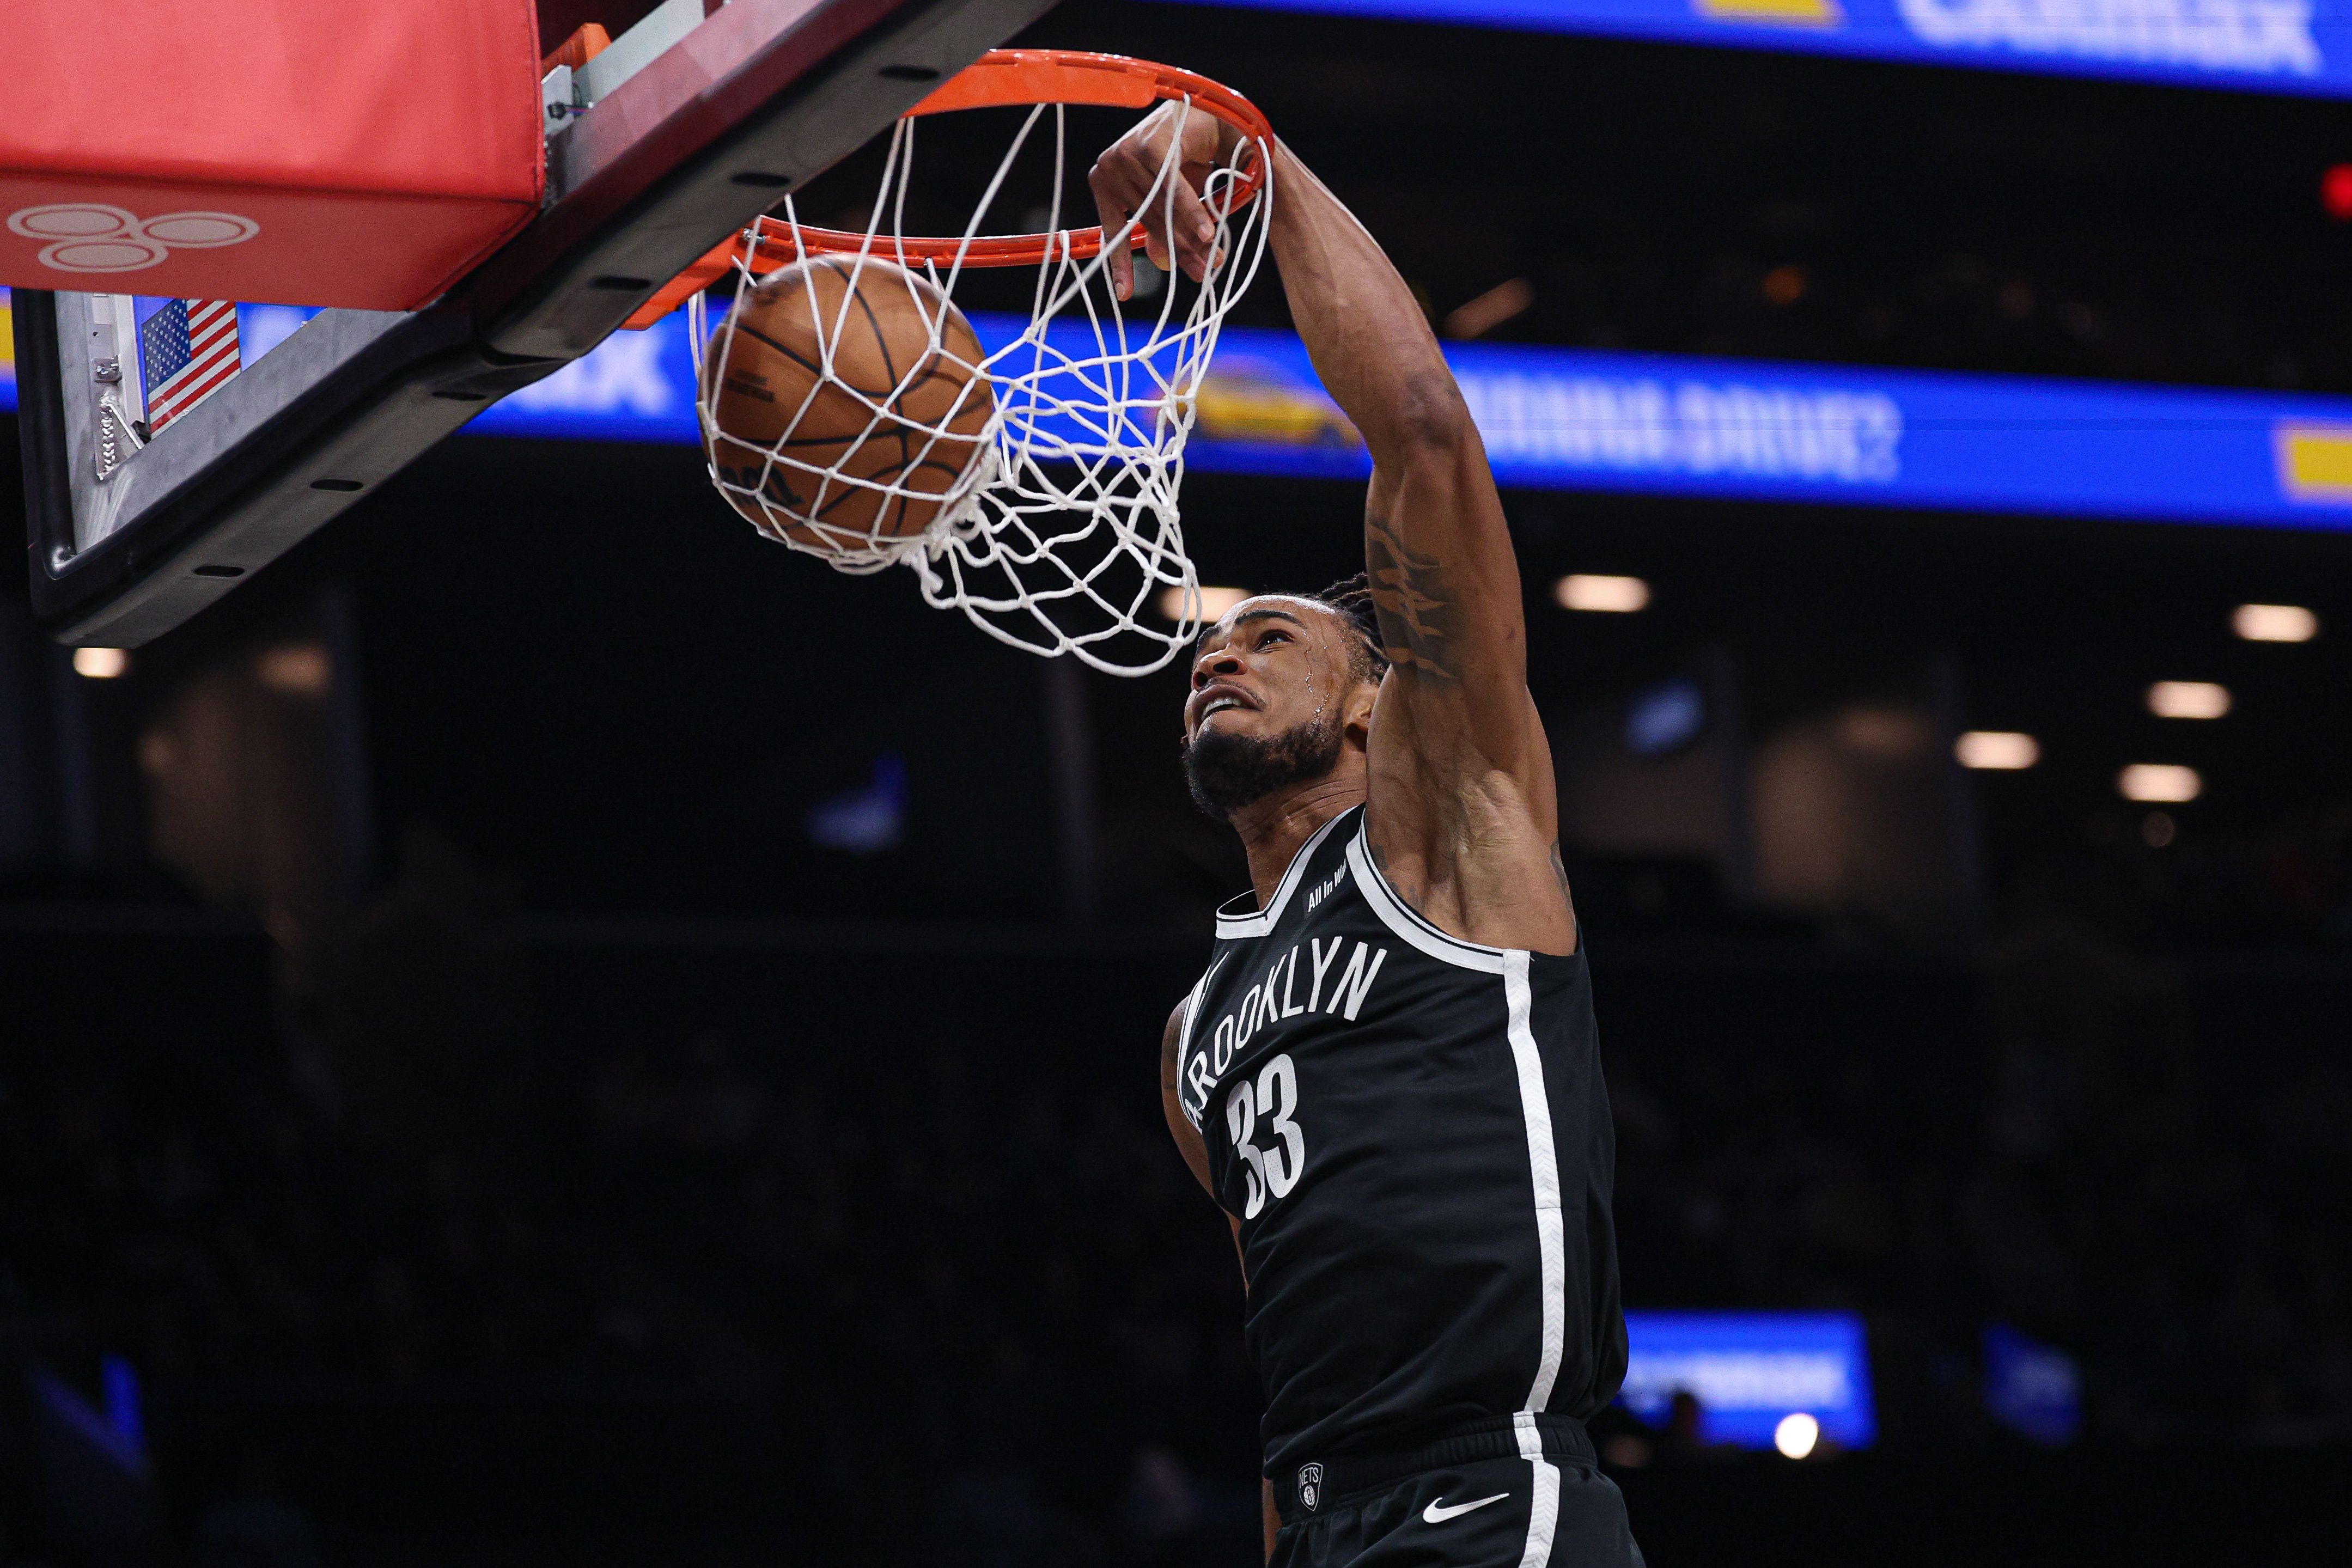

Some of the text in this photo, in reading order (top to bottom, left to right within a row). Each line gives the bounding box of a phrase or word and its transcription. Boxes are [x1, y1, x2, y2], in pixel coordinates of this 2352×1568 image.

[1308, 885, 1321, 913] All
[1324, 880, 1333, 899] In
[1226, 1053, 1305, 1220] 33
[1299, 1467, 1319, 1489] NETS
